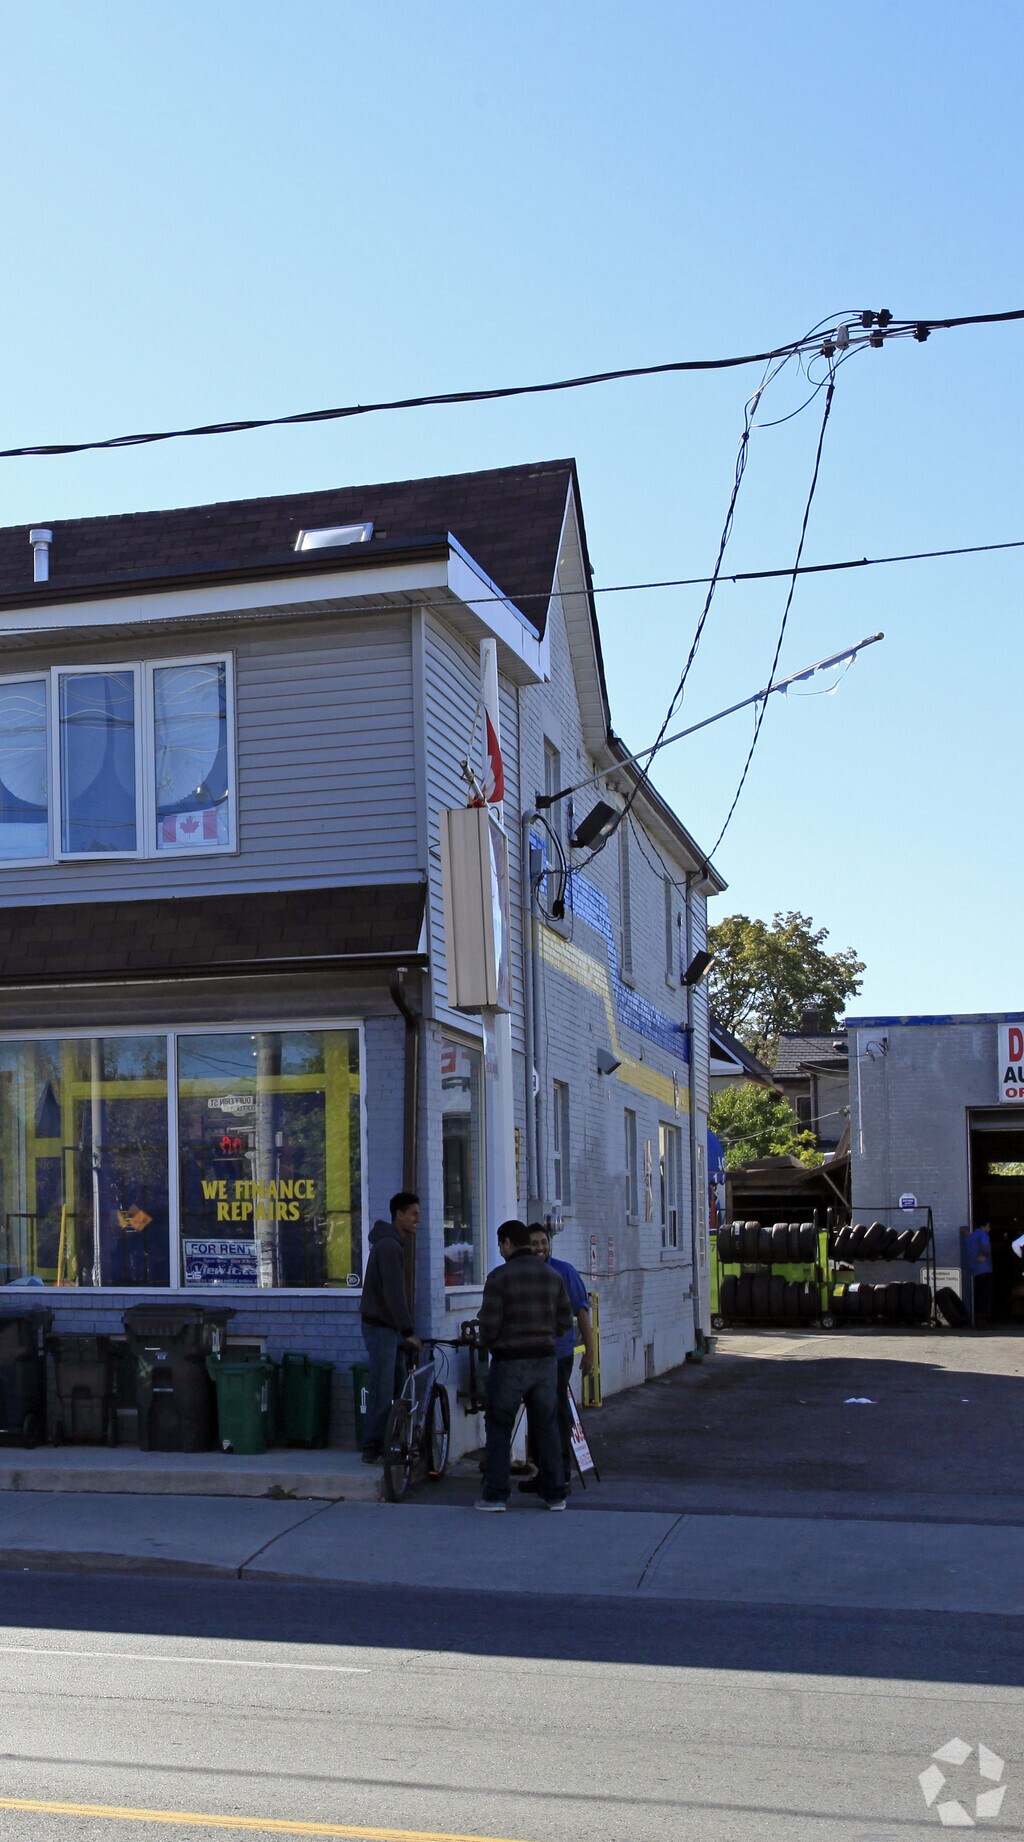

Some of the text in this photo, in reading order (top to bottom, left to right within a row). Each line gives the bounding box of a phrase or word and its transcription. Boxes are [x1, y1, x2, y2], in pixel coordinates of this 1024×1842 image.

[201, 1179, 316, 1200] WE FINANCE
[217, 1201, 301, 1221] REPAIRS
[191, 1243, 252, 1255] FOR RENT
